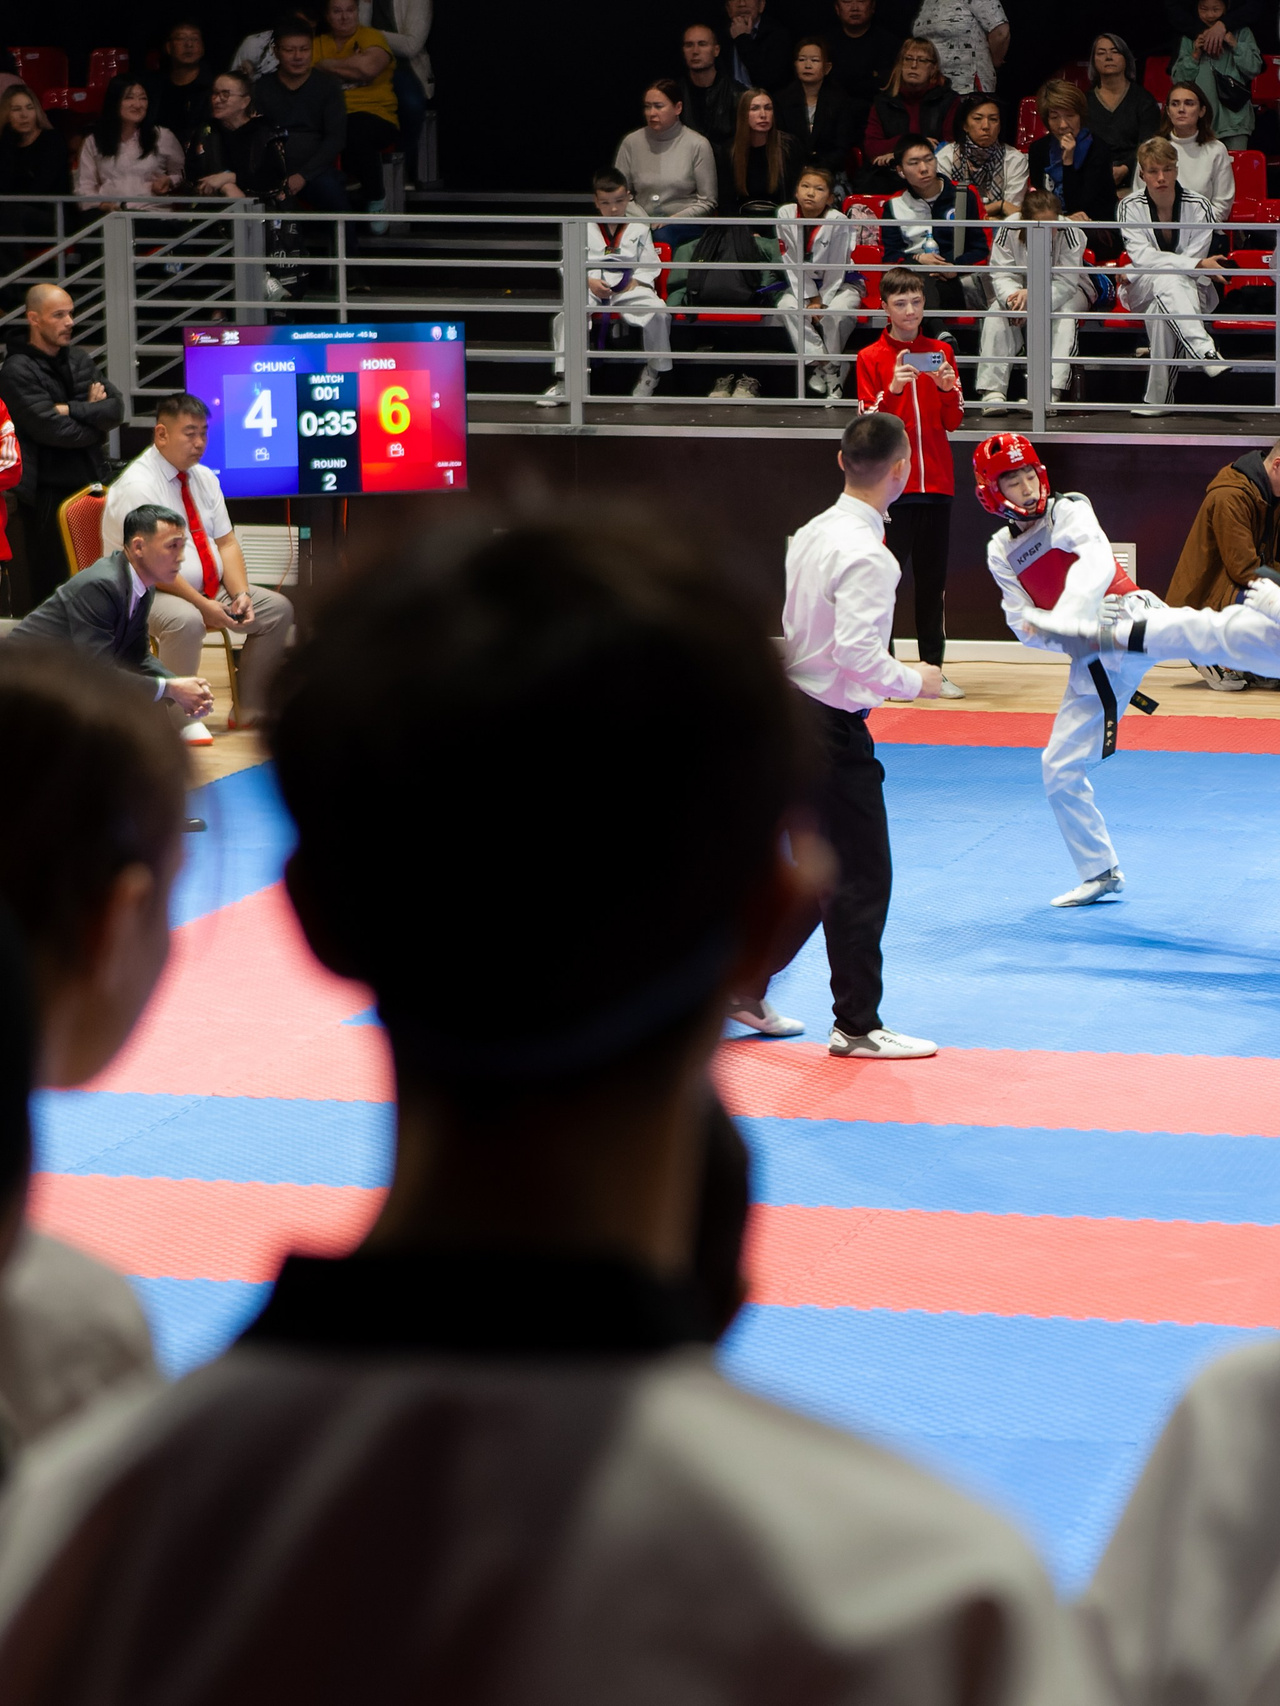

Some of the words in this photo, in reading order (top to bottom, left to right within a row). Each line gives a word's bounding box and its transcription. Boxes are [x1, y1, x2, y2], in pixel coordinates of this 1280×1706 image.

[334, 331, 354, 339] Junior
[368, 331, 378, 339] kg
[253, 361, 296, 373] CHUNG
[362, 359, 396, 370] HONG
[311, 375, 344, 384] MATCH
[313, 386, 340, 401] 001
[244, 389, 277, 437] 4
[379, 386, 411, 434] 6
[300, 411, 358, 437] 0:35
[312, 459, 347, 469] ROUND
[323, 474, 337, 491] 2
[445, 469, 454, 485] 1
